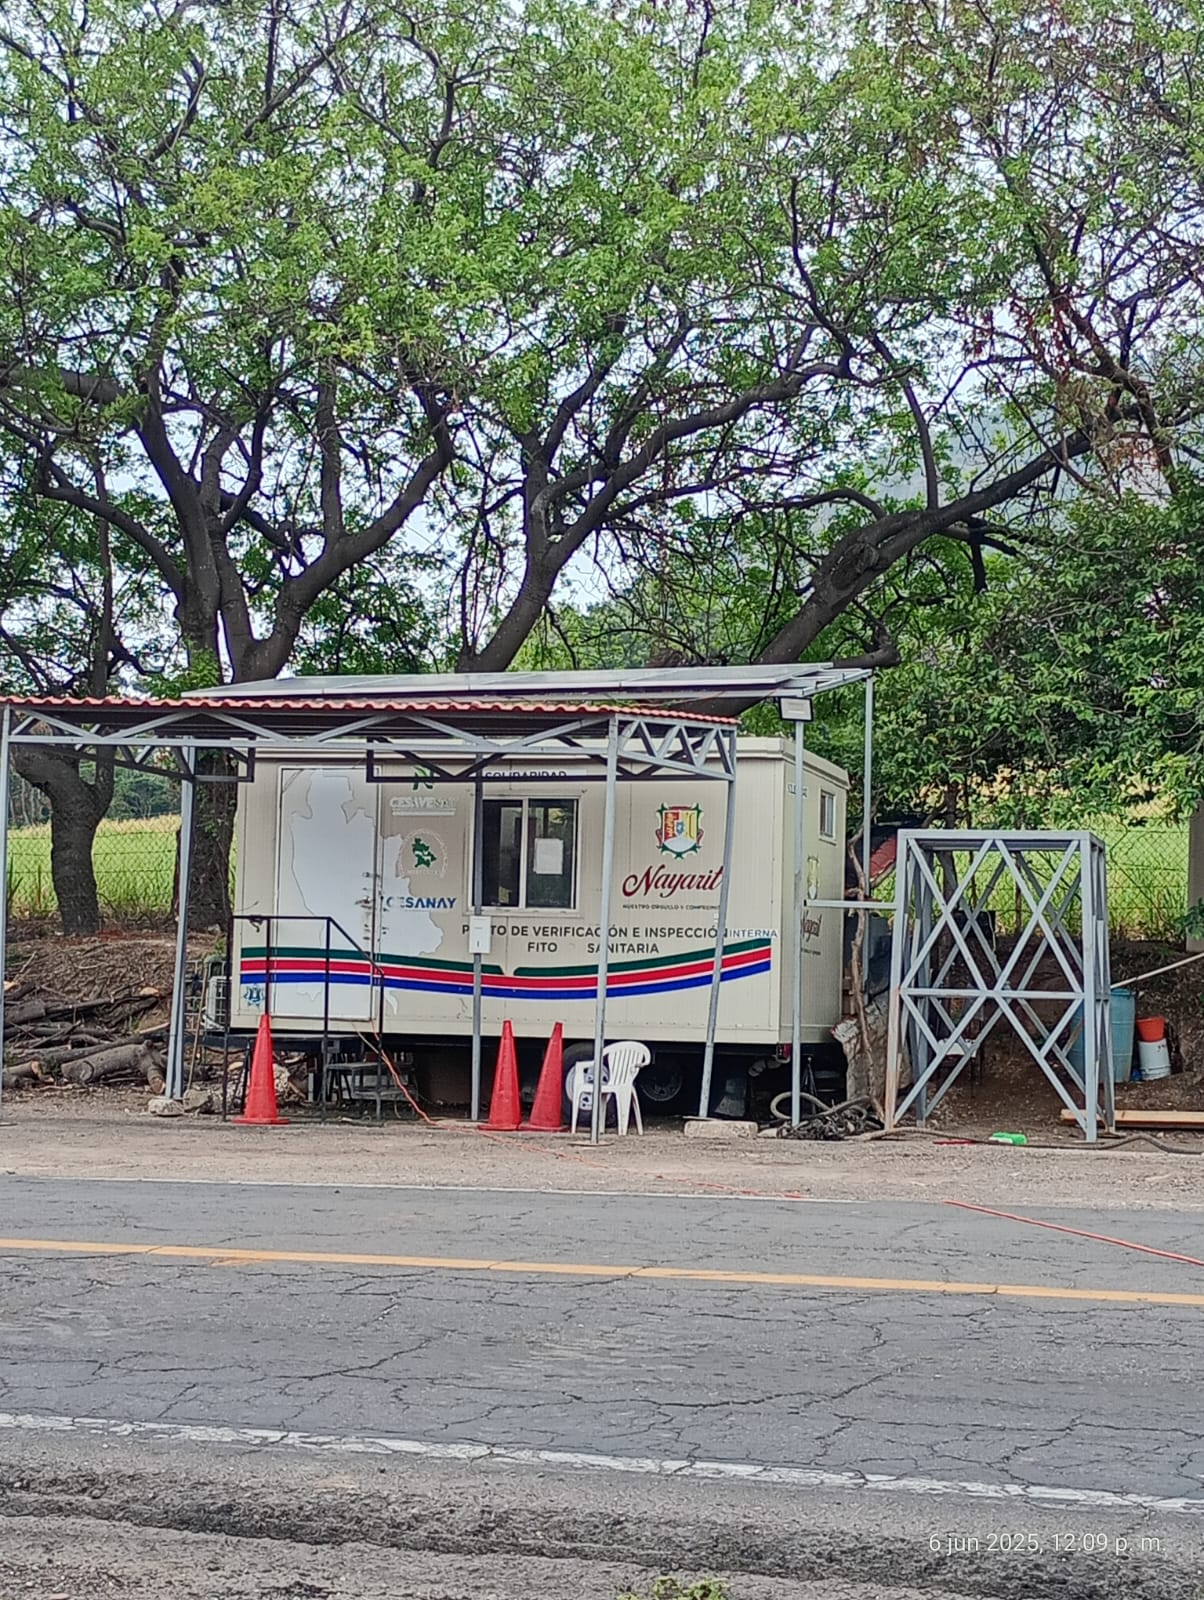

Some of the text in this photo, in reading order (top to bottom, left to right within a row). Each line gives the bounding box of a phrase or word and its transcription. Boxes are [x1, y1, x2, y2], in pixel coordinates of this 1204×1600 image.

[622, 864, 724, 898] Nayarit
[462, 924, 507, 936] PTO
[511, 925, 529, 937] DE
[532, 924, 628, 938] VERIFICACÓN
[632, 927, 641, 937] E
[729, 928, 778, 938] INTERNA
[527, 941, 558, 953] FITO
